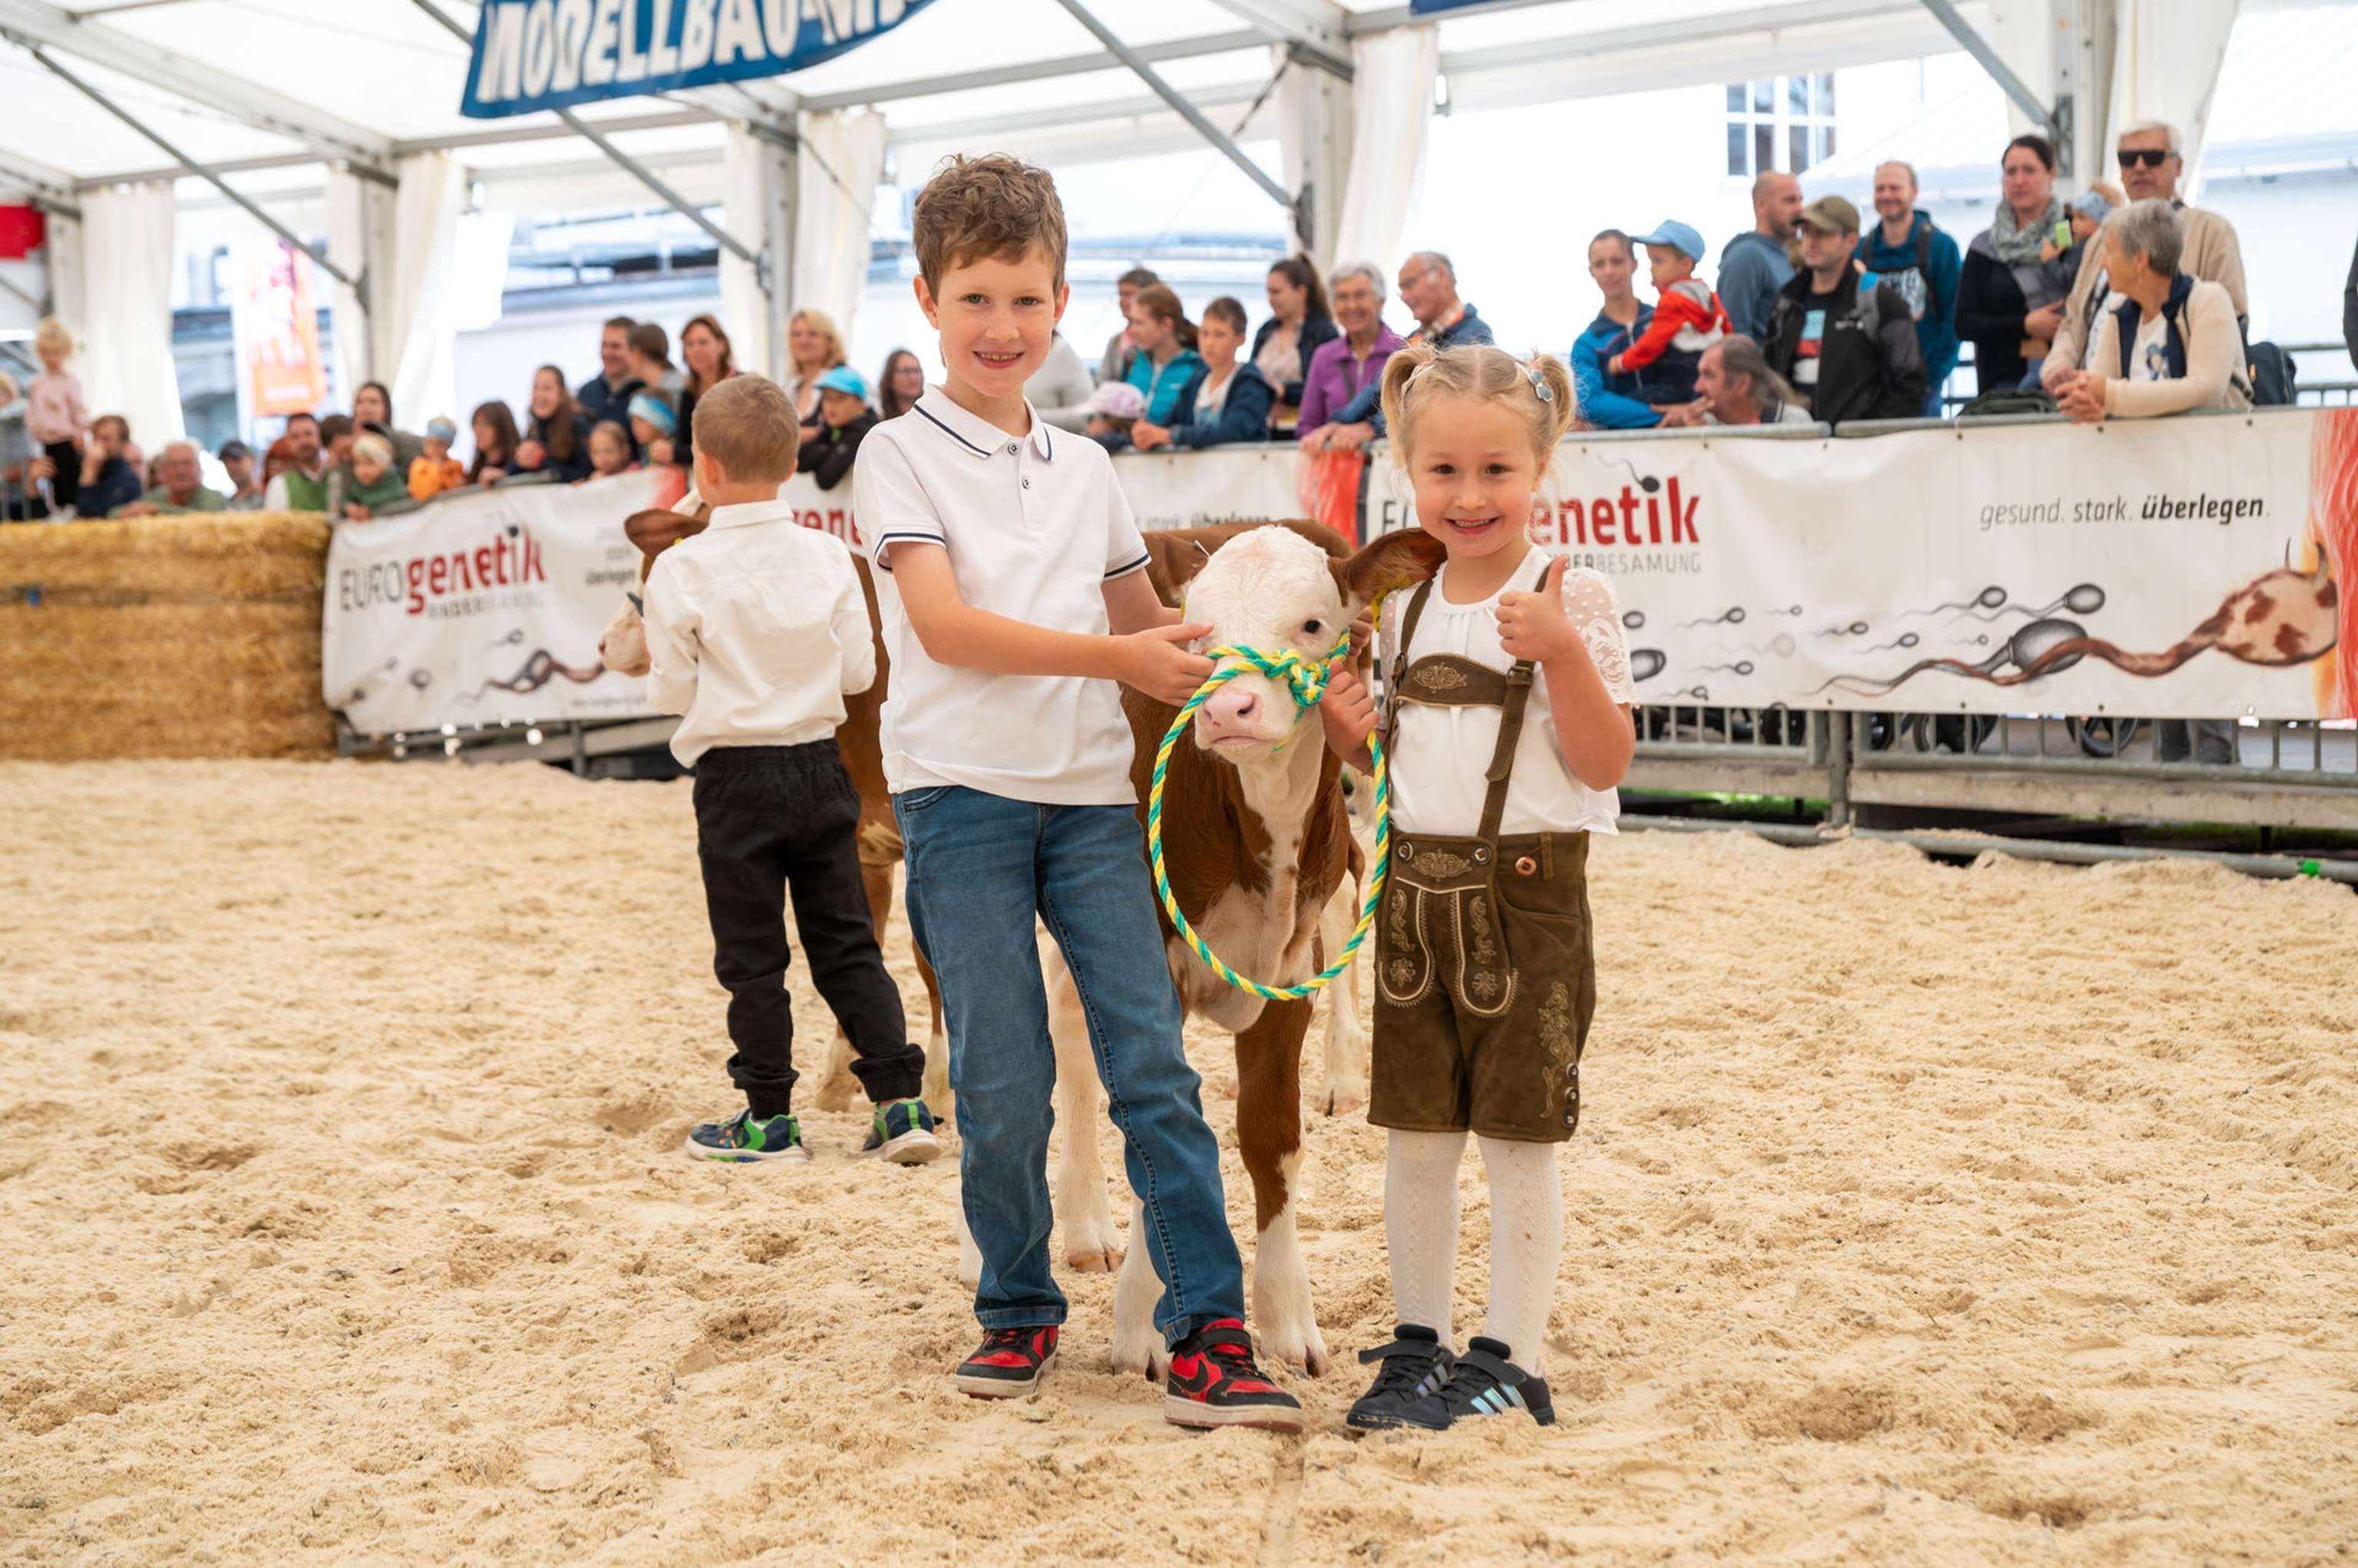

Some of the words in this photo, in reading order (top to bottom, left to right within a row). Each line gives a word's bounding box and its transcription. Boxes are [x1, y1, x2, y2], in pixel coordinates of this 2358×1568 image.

[475, 0, 909, 103] MODELLBAU-
[1980, 497, 2065, 531] gesund.
[2072, 494, 2133, 523] stark.
[2141, 494, 2270, 525] überlegen.
